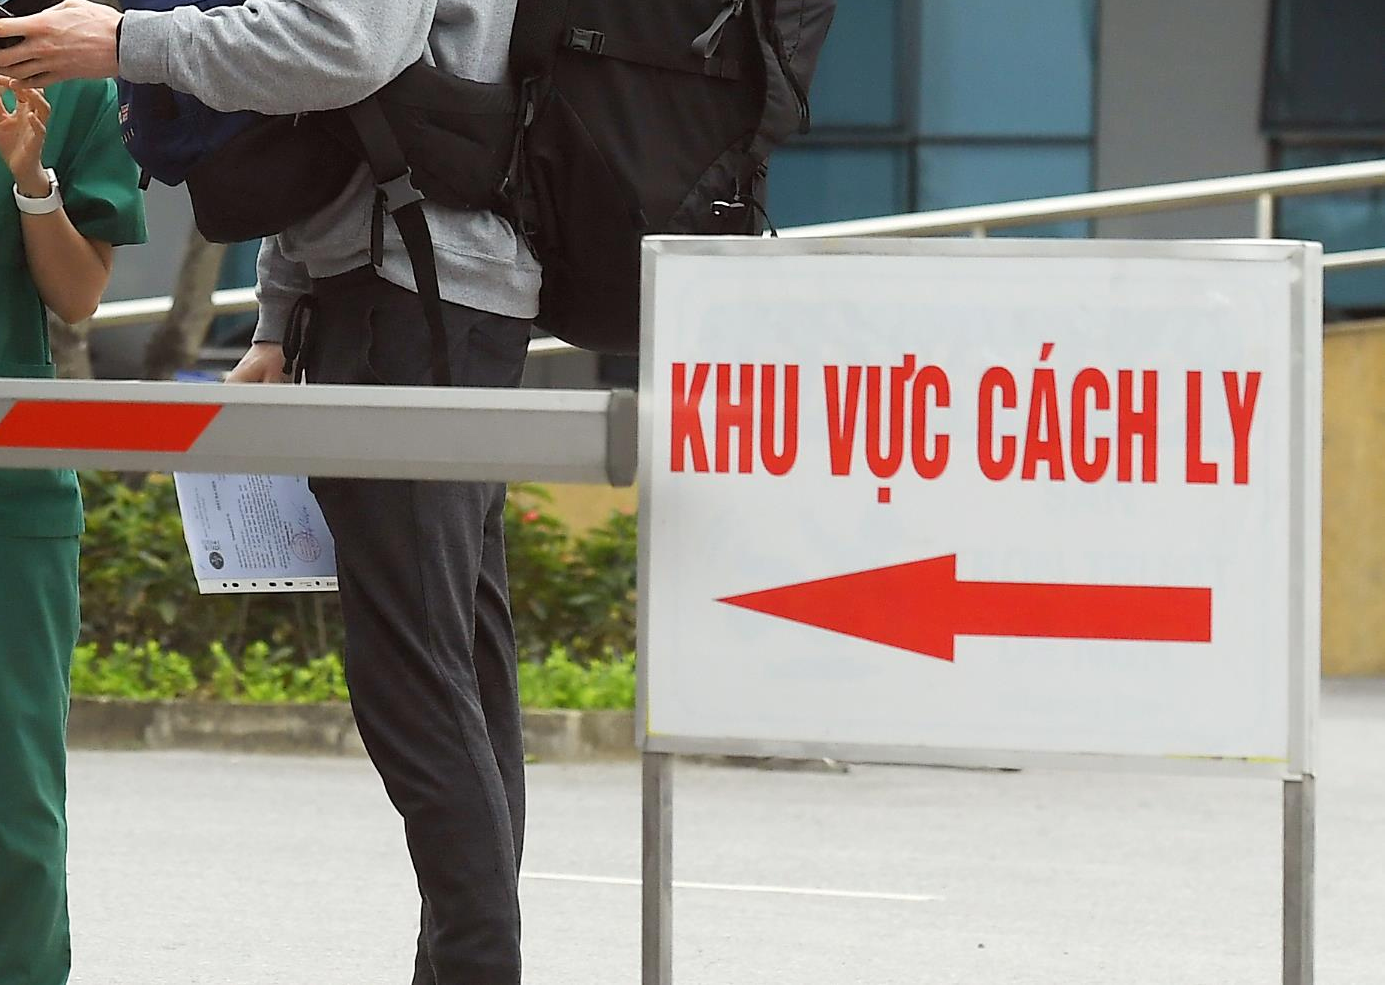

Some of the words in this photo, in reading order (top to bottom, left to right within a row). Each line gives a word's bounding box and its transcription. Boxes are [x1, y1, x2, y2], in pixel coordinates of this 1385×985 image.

[669, 362, 800, 476] KHU
[823, 353, 952, 504] VỰC
[977, 342, 1158, 483] CÁCH
[1185, 370, 1262, 485] LY
